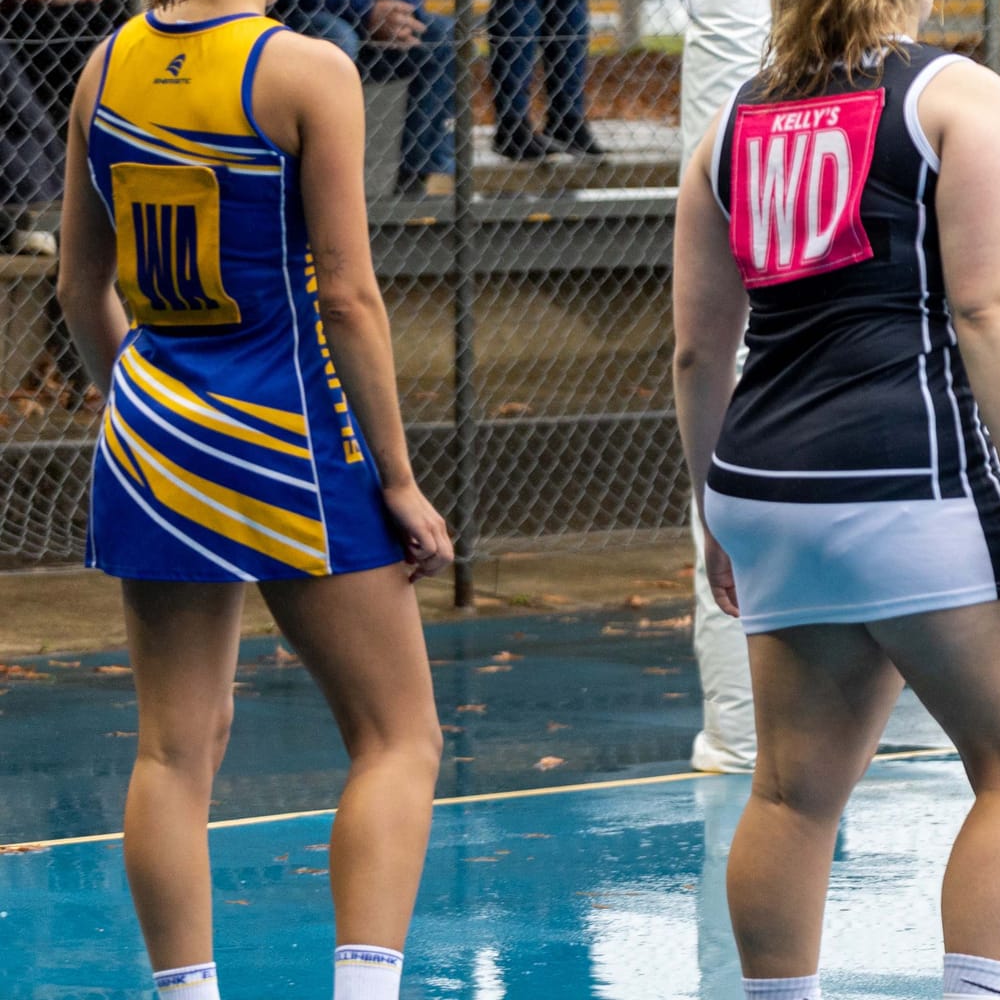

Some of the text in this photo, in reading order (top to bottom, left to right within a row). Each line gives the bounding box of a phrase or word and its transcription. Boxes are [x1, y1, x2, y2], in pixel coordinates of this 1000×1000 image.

[771, 106, 841, 132] KELLY'S
[747, 128, 852, 271] WD
[131, 202, 220, 310] WA
